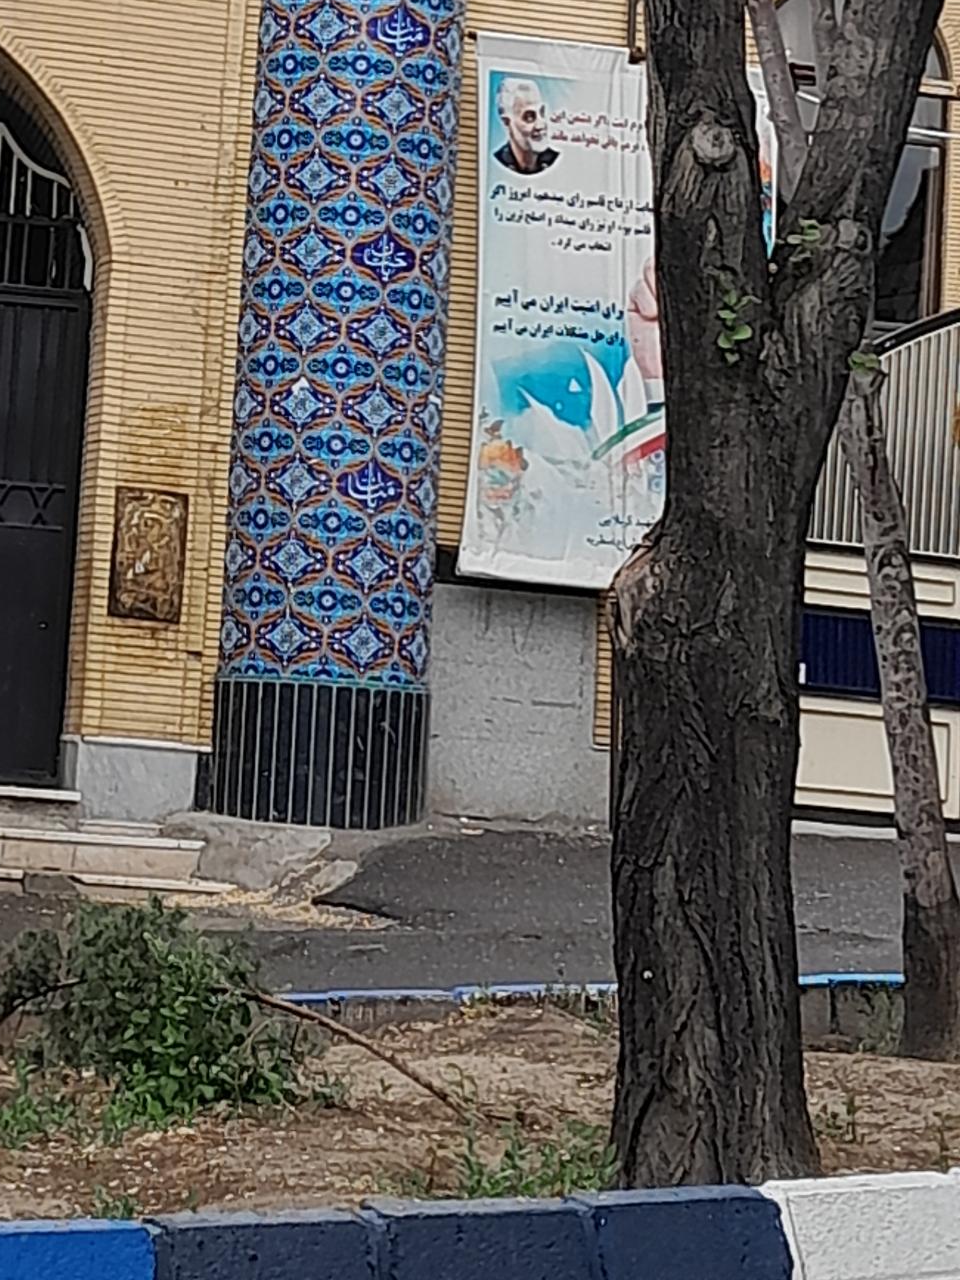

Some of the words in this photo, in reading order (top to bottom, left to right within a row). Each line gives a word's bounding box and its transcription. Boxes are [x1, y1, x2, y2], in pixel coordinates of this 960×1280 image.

[520, 298, 538, 311] می
[538, 294, 569, 314] ایران
[570, 299, 600, 316] امنیت
